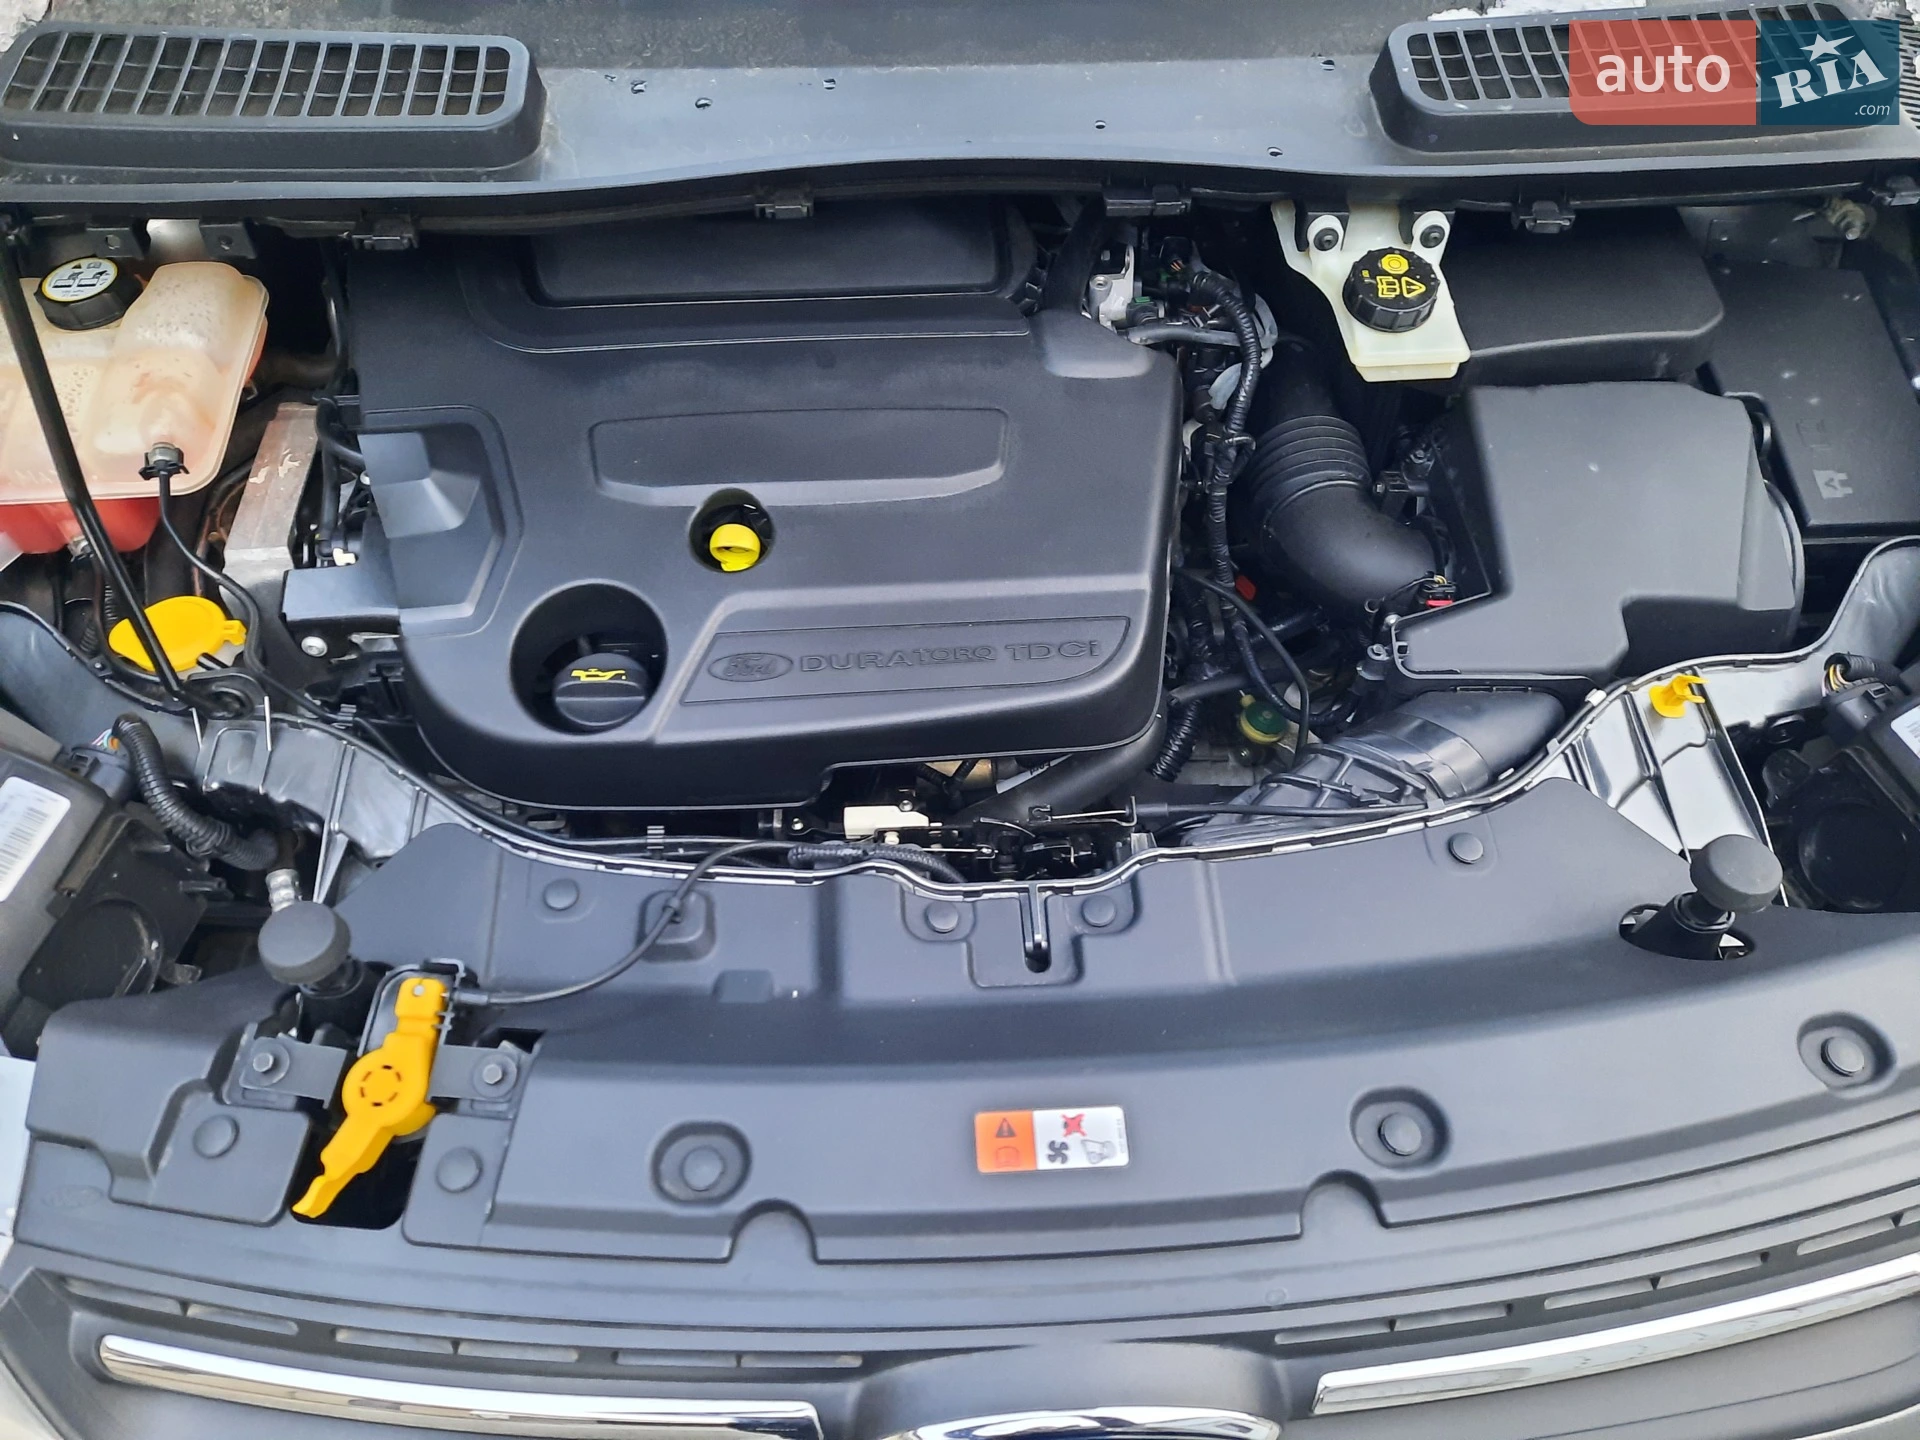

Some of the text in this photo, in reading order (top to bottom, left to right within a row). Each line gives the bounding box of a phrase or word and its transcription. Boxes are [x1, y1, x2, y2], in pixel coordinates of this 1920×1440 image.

[723, 639, 1100, 678] Ford DURATORQ TDCi
